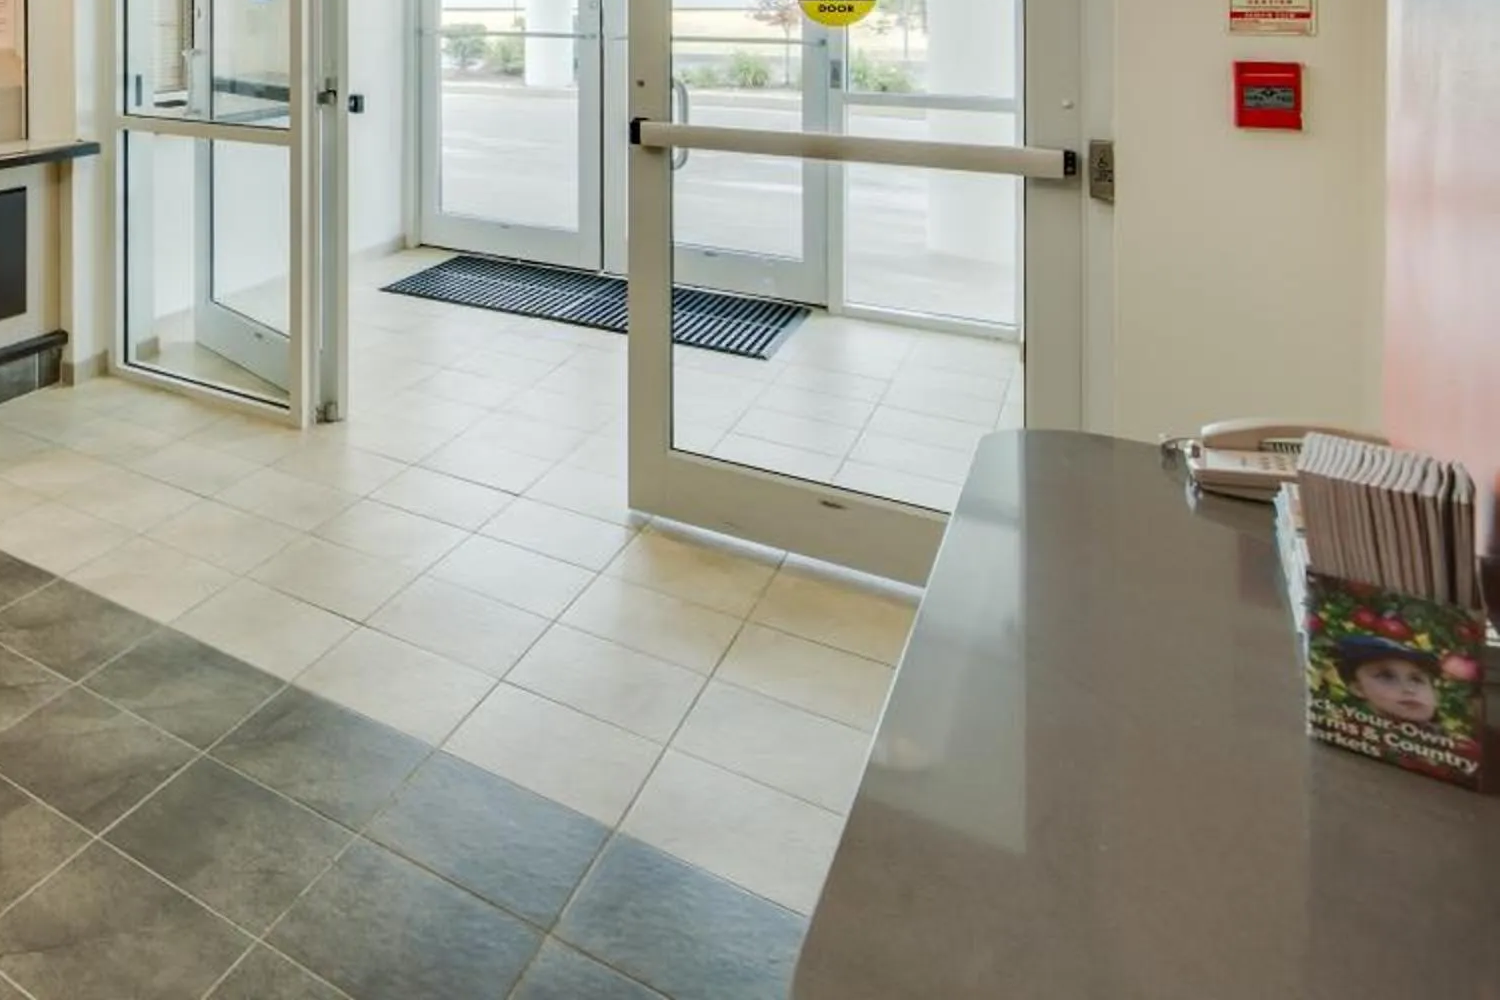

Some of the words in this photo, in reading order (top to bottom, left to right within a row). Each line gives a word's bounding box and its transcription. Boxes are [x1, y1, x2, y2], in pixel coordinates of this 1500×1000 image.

[818, 4, 854, 13] DOOR
[1308, 711, 1360, 736] arms
[1362, 724, 1380, 741] &
[1383, 732, 1480, 774] Country
